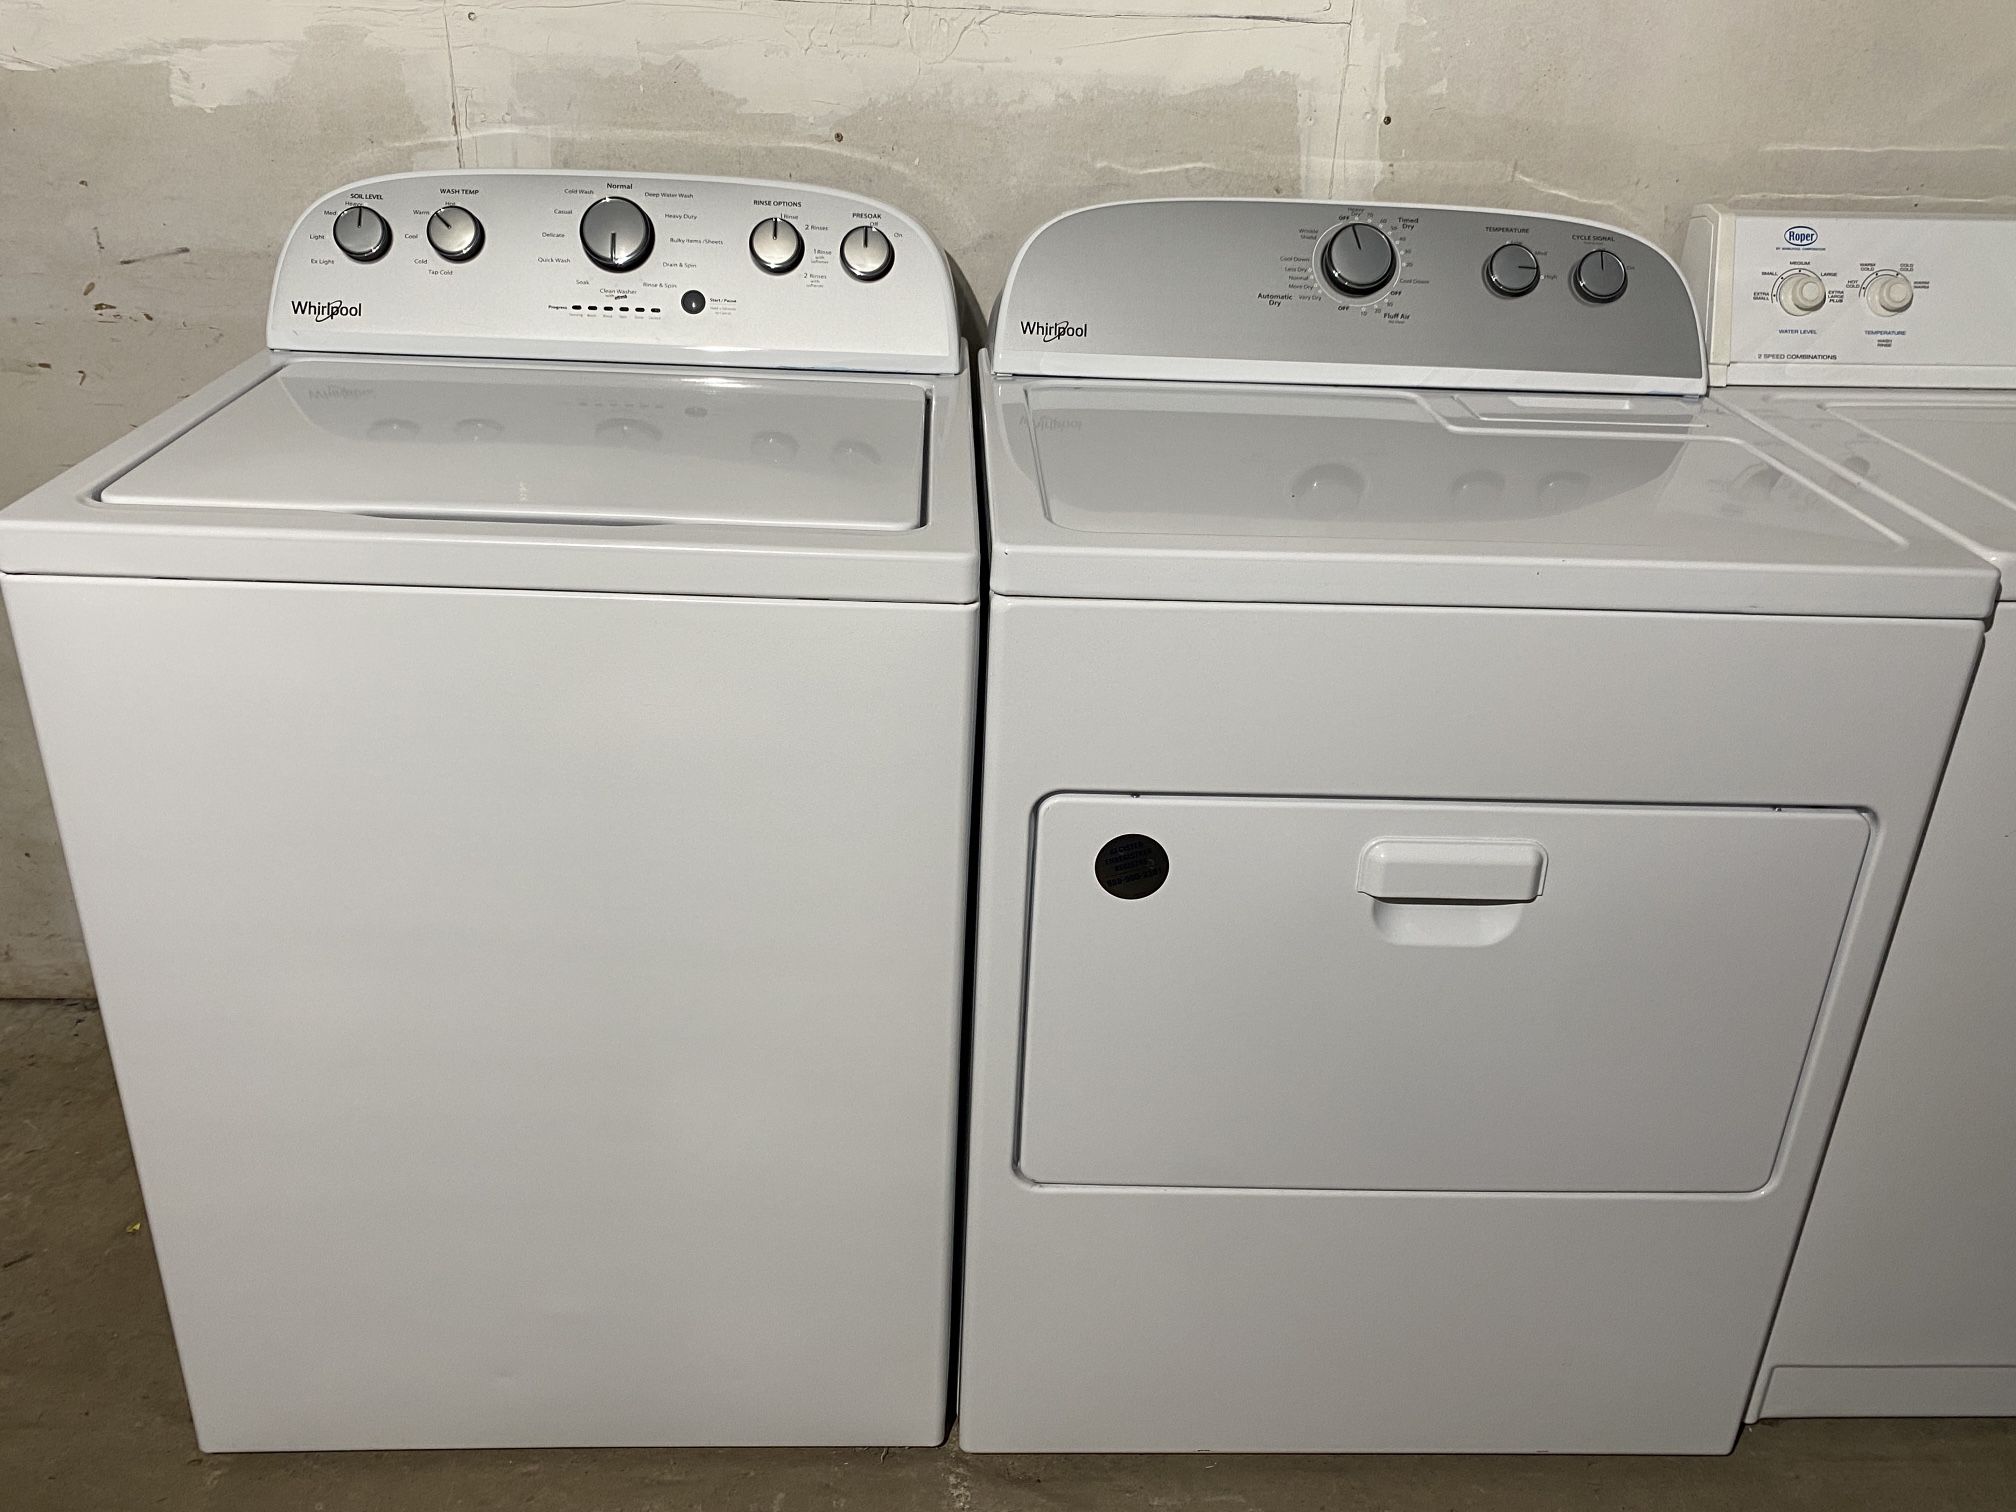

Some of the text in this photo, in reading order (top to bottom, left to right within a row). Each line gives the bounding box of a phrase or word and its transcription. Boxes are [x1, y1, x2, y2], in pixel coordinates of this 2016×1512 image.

[773, 200, 802, 208] OPTIONS
[1402, 223, 1415, 231] Dry
[1788, 231, 1815, 243] Roper
[1257, 293, 1293, 301] Automatic
[1268, 300, 1282, 308] Dry
[291, 300, 362, 322] Whirlpool
[1021, 321, 1088, 343] Whirlpool
